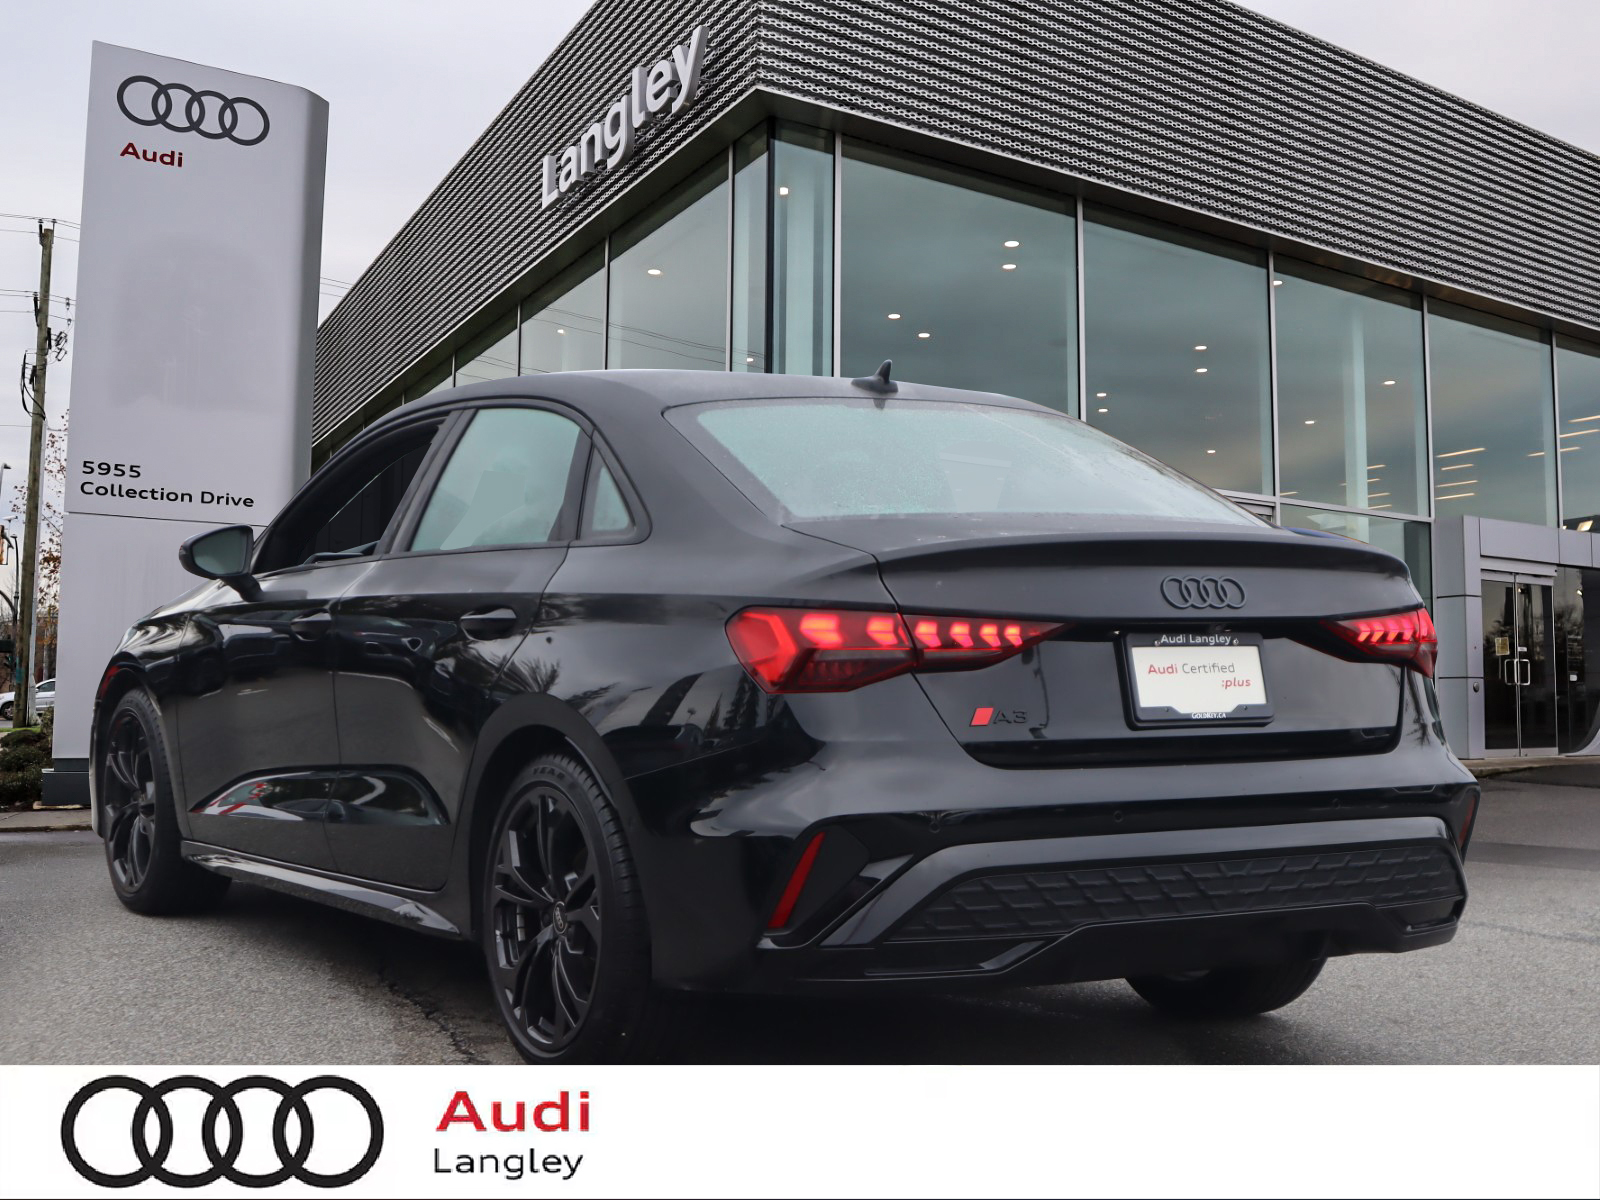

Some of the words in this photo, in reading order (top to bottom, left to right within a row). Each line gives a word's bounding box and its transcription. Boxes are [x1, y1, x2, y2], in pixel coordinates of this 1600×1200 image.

[541, 25, 709, 209] Langley
[119, 142, 184, 168] Audi
[82, 460, 142, 479] 5955
[79, 481, 193, 504] Collection
[199, 490, 255, 508] Drive
[1160, 634, 1187, 644] Audi
[1189, 634, 1231, 646] Langley
[1148, 664, 1178, 675] Audi
[1182, 663, 1236, 675] Certified
[993, 710, 1028, 724] A3
